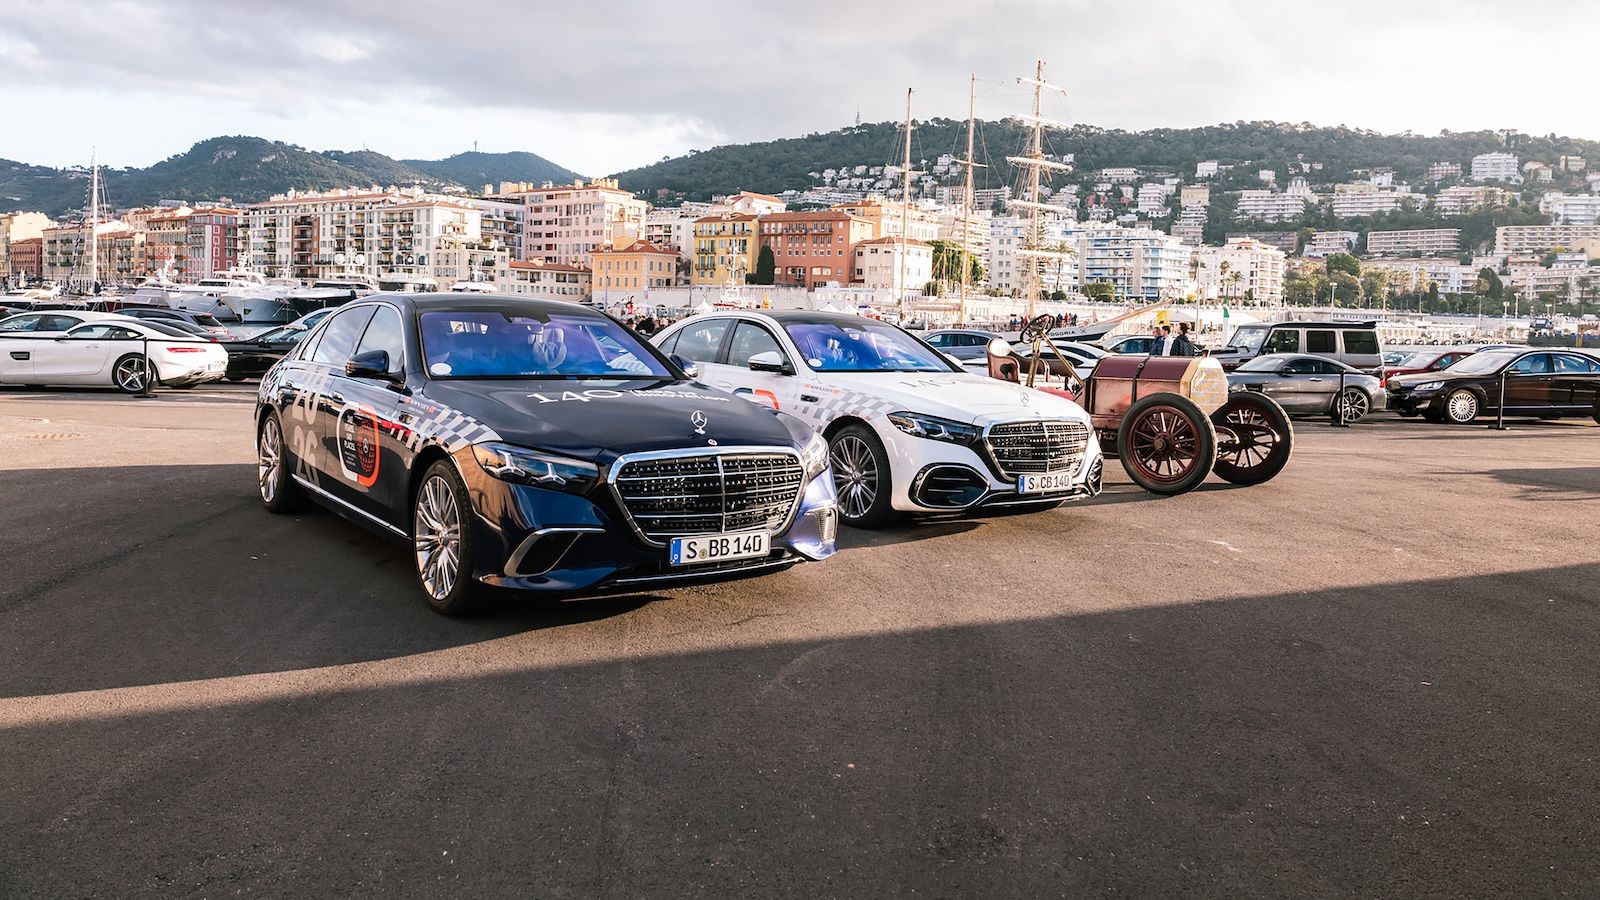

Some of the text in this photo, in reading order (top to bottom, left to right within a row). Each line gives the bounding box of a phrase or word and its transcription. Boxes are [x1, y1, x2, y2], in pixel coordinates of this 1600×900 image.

[292, 366, 328, 425] 20
[526, 389, 624, 404] 140
[293, 425, 320, 486] 26
[1028, 477, 1035, 490] S
[1040, 476, 1053, 489] CB
[1053, 474, 1070, 488] 140
[686, 535, 762, 559] S BB 140
